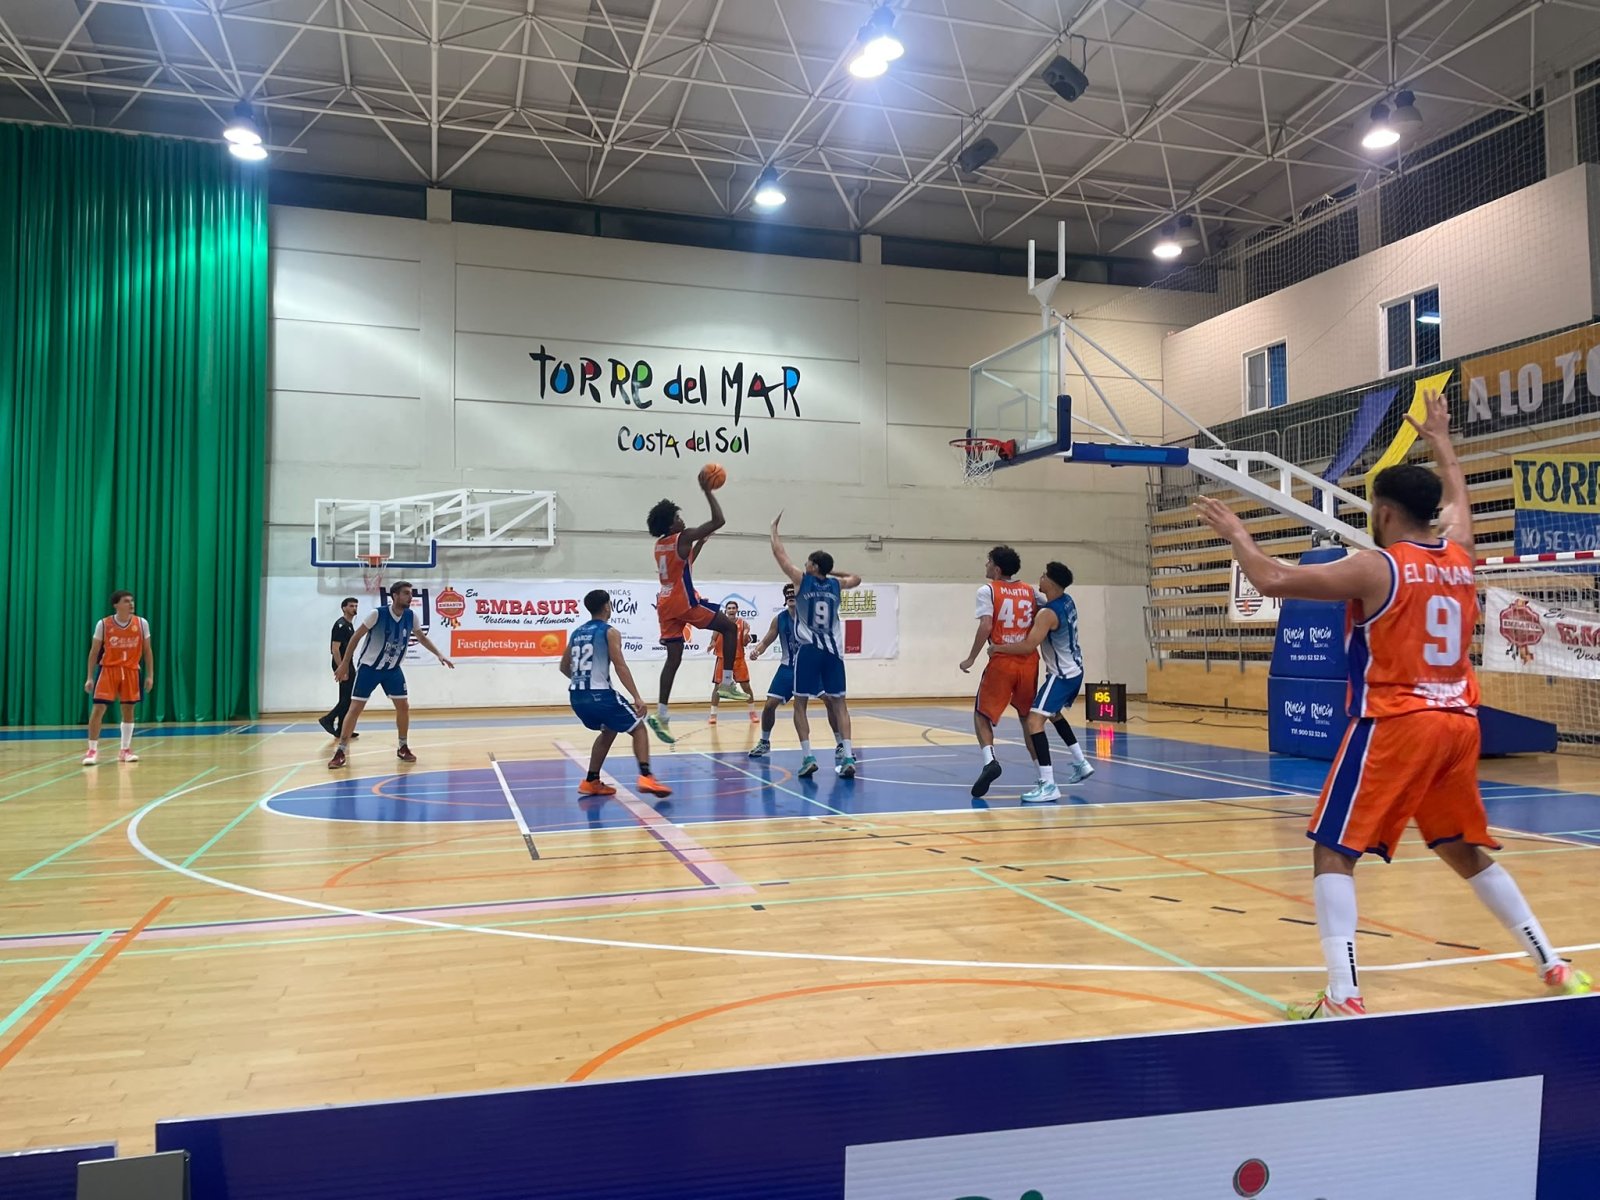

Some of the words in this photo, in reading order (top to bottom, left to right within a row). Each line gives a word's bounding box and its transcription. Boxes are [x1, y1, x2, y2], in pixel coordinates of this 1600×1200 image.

[664, 365, 707, 406] del
[1467, 376, 1492, 423] A
[1499, 363, 1543, 417] LO
[686, 430, 710, 453] del
[716, 427, 749, 455] Sol
[1404, 563, 1424, 584] EL
[466, 588, 478, 598] En
[475, 598, 579, 616] EMBASUR
[815, 600, 829, 627] 9
[997, 598, 1032, 629] 43
[1543, 608, 1565, 619] En
[523, 617, 533, 625] los
[1423, 594, 1462, 666] 9
[457, 638, 536, 652] Fastighetsbyrån
[624, 641, 643, 652] Rojo
[571, 643, 594, 673] 32
[1099, 704, 1114, 717] 14
